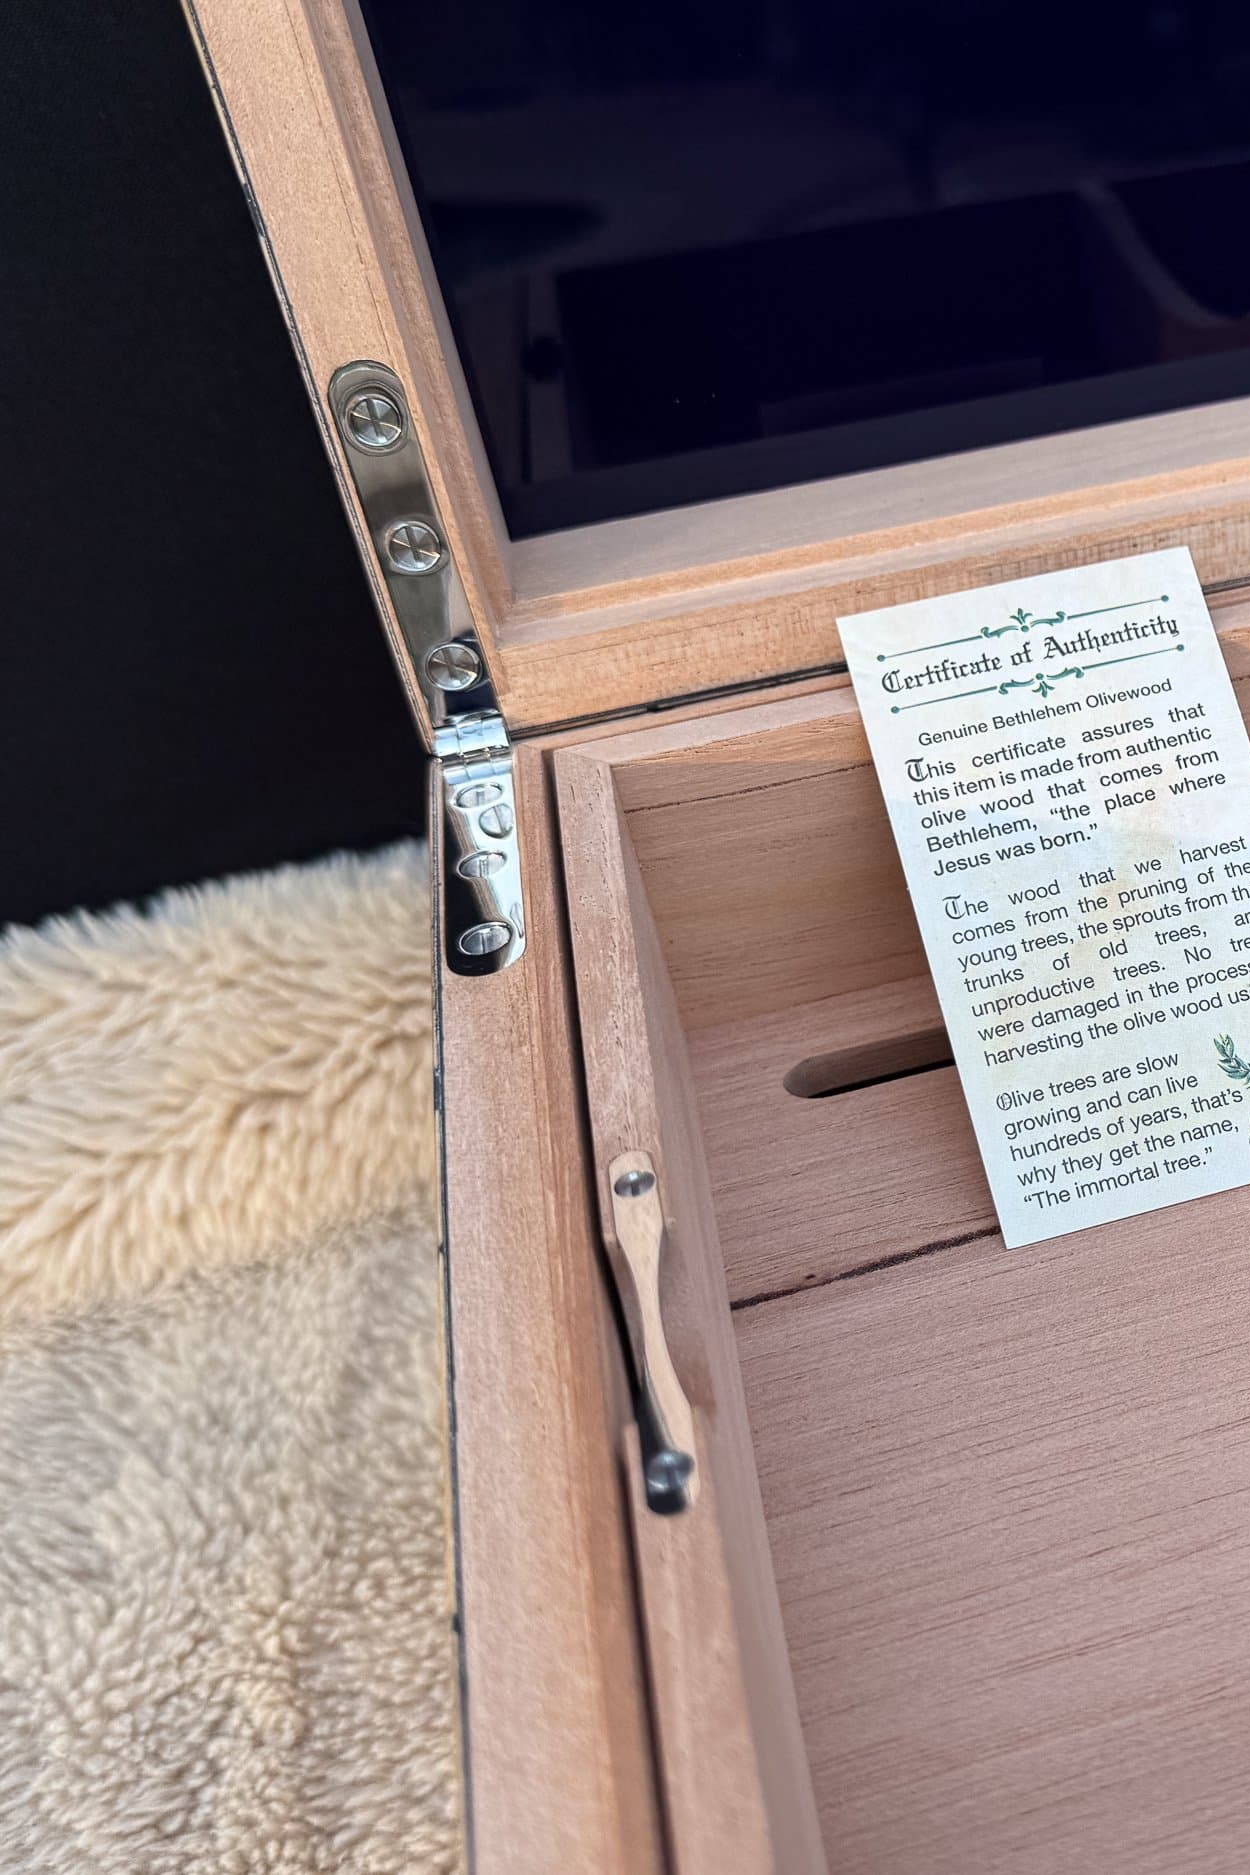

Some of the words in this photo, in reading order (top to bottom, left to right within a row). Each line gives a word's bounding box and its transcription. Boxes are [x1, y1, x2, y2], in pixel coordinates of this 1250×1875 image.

[881, 652, 1003, 694] Certificate
[1009, 640, 1034, 667] of
[1042, 615, 1180, 660] Authenticity
[904, 756, 957, 783] This
[971, 736, 1067, 768] certificate
[1081, 716, 1155, 744] assures
[1167, 702, 1207, 724] that
[918, 722, 989, 747] Genuine
[991, 701, 1082, 730] Bethlehem
[1085, 677, 1173, 709] Olivewood
[912, 786, 951, 806] this
[952, 777, 997, 797] item
[998, 770, 1017, 787] is
[1020, 757, 1075, 782] made
[1076, 748, 1122, 769] from
[1125, 725, 1213, 758] authentic
[920, 808, 967, 830] olive
[979, 788, 1035, 816] wood
[1046, 777, 1087, 800] that
[1099, 763, 1164, 787] comes
[1174, 750, 1220, 771] from
[925, 818, 1038, 853] Bethlehem,
[1049, 804, 1091, 822] “the
[1103, 788, 1157, 816] place
[1168, 773, 1227, 796] where
[933, 852, 992, 877] Jesus
[994, 841, 1036, 862] was
[1038, 822, 1098, 852] born.”
[941, 893, 990, 920] The
[1007, 878, 1062, 906] wood
[1077, 866, 1117, 889] that
[1133, 858, 1163, 875] we
[1178, 835, 1248, 865] harvest
[951, 919, 1017, 945] comes
[1023, 906, 1069, 928] from
[1076, 894, 1109, 914] the
[1116, 876, 1188, 909] pruning
[1196, 865, 1215, 885] of
[956, 943, 1018, 974] young
[1019, 931, 1075, 953] trees,
[1076, 921, 1109, 941] the
[1111, 903, 1183, 935] sprouts
[1184, 892, 1229, 913] from
[963, 967, 1025, 993] trunks
[1052, 951, 1071, 972] of
[1098, 937, 1129, 960] old
[1153, 924, 1207, 946] trees,
[971, 976, 1096, 1018] unproductive
[1112, 960, 1166, 982] trees.
[1183, 945, 1212, 965] No
[977, 1019, 1025, 1042] were
[1030, 991, 1121, 1029] damaged
[1124, 988, 1144, 1005] in
[1147, 980, 1180, 999] the
[983, 1030, 1084, 1067] harvesting
[1086, 1022, 1119, 1040] the
[1122, 1009, 1167, 1031] olive
[1169, 991, 1224, 1019] wood
[995, 1088, 1045, 1112] Olive
[1047, 1074, 1098, 1098] trees
[1101, 1065, 1132, 1085] are
[1135, 1052, 1179, 1075] slow
[1003, 1105, 1082, 1141] growing
[1085, 1090, 1123, 1116] and
[1127, 1084, 1163, 1104] can
[1164, 1075, 1199, 1095] live
[1009, 1125, 1102, 1162] hundreds
[1106, 1115, 1125, 1136] of
[1128, 1105, 1188, 1135] years,
[1190, 1087, 1243, 1114] that’s
[1016, 1164, 1057, 1187] why
[1060, 1152, 1103, 1175] they
[1108, 1140, 1142, 1167] get
[1143, 1134, 1176, 1153] the
[1179, 1119, 1239, 1145] name,
[1023, 1189, 1072, 1209] “The
[1073, 1160, 1160, 1199] immortal
[1162, 1145, 1213, 1175] tree.”
